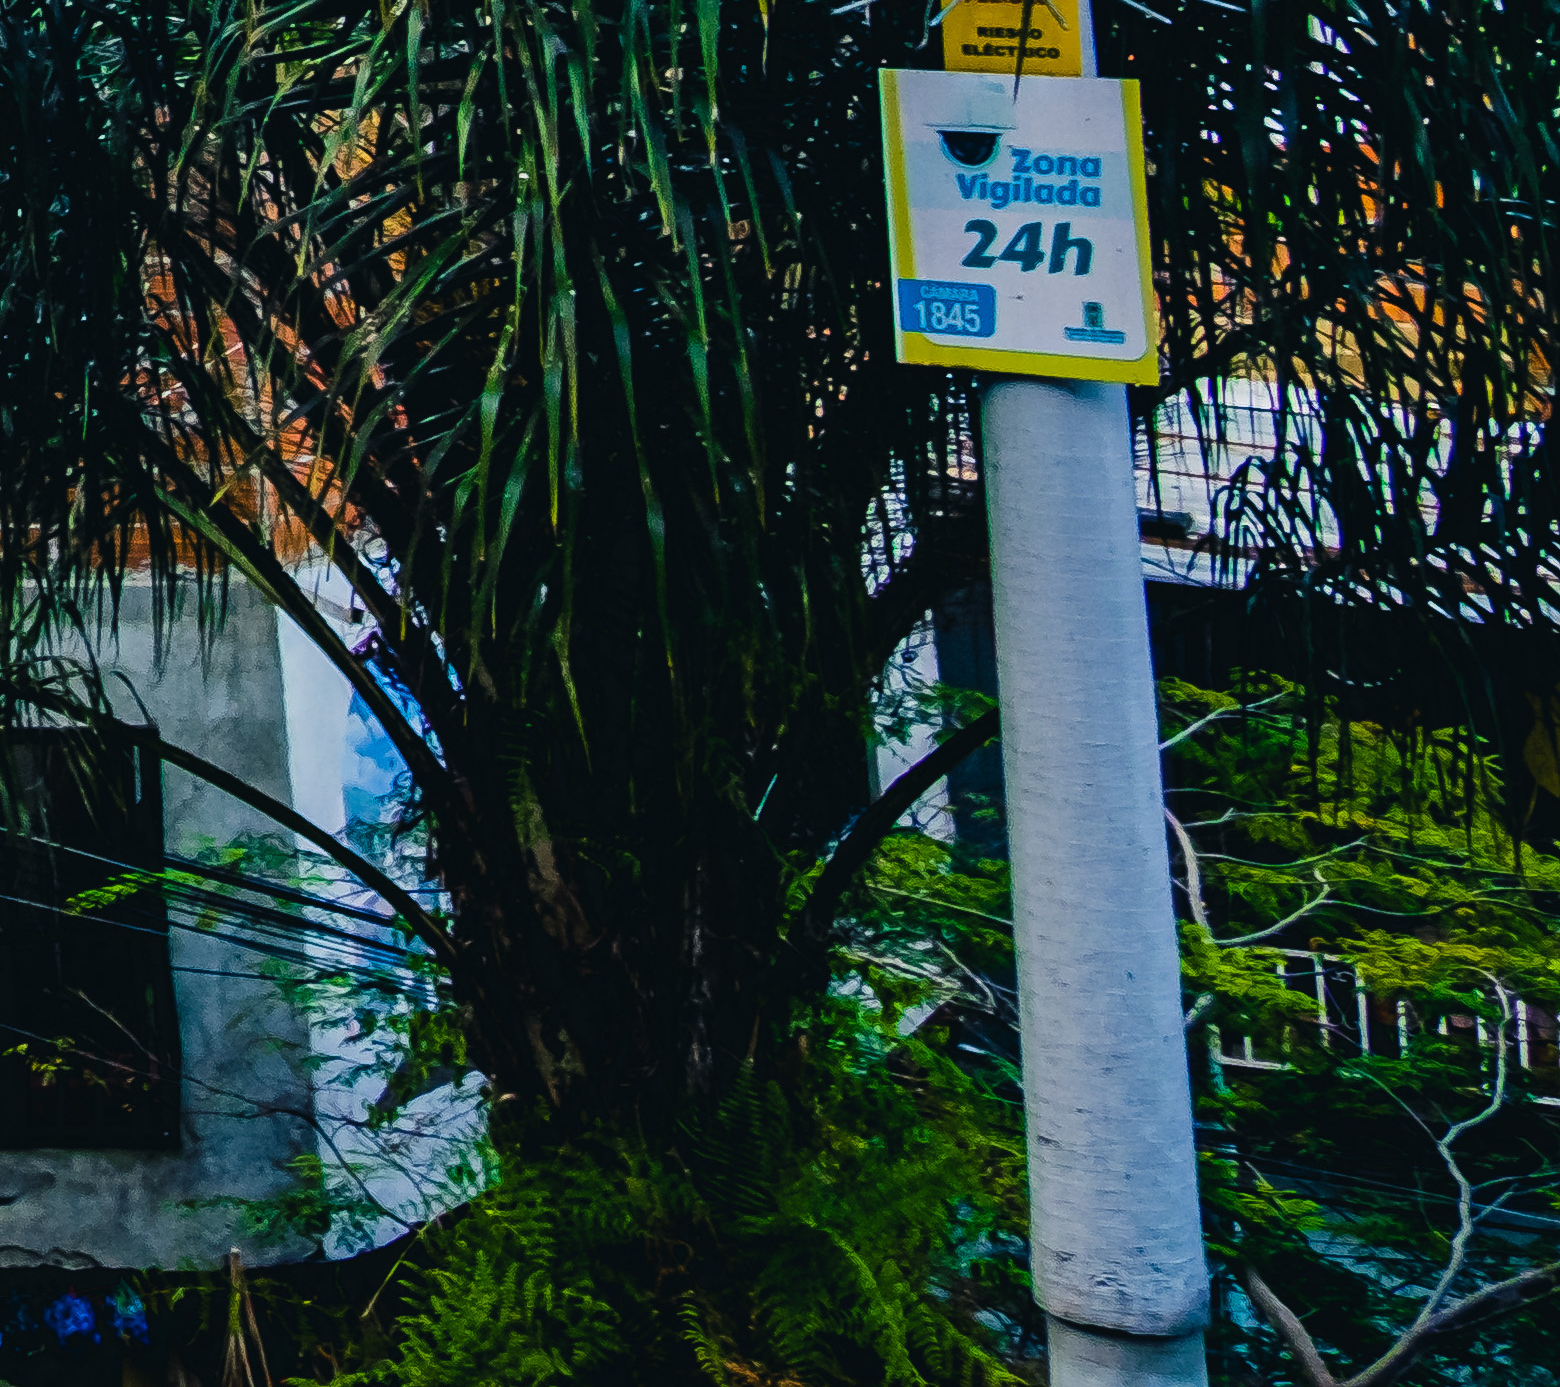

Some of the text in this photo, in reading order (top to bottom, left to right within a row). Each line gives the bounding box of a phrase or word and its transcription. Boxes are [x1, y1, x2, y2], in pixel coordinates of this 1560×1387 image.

[1009, 147, 1103, 179] Zona
[955, 171, 1103, 211] Vigilada
[960, 218, 1095, 277] 24h
[912, 299, 981, 333] 1845
